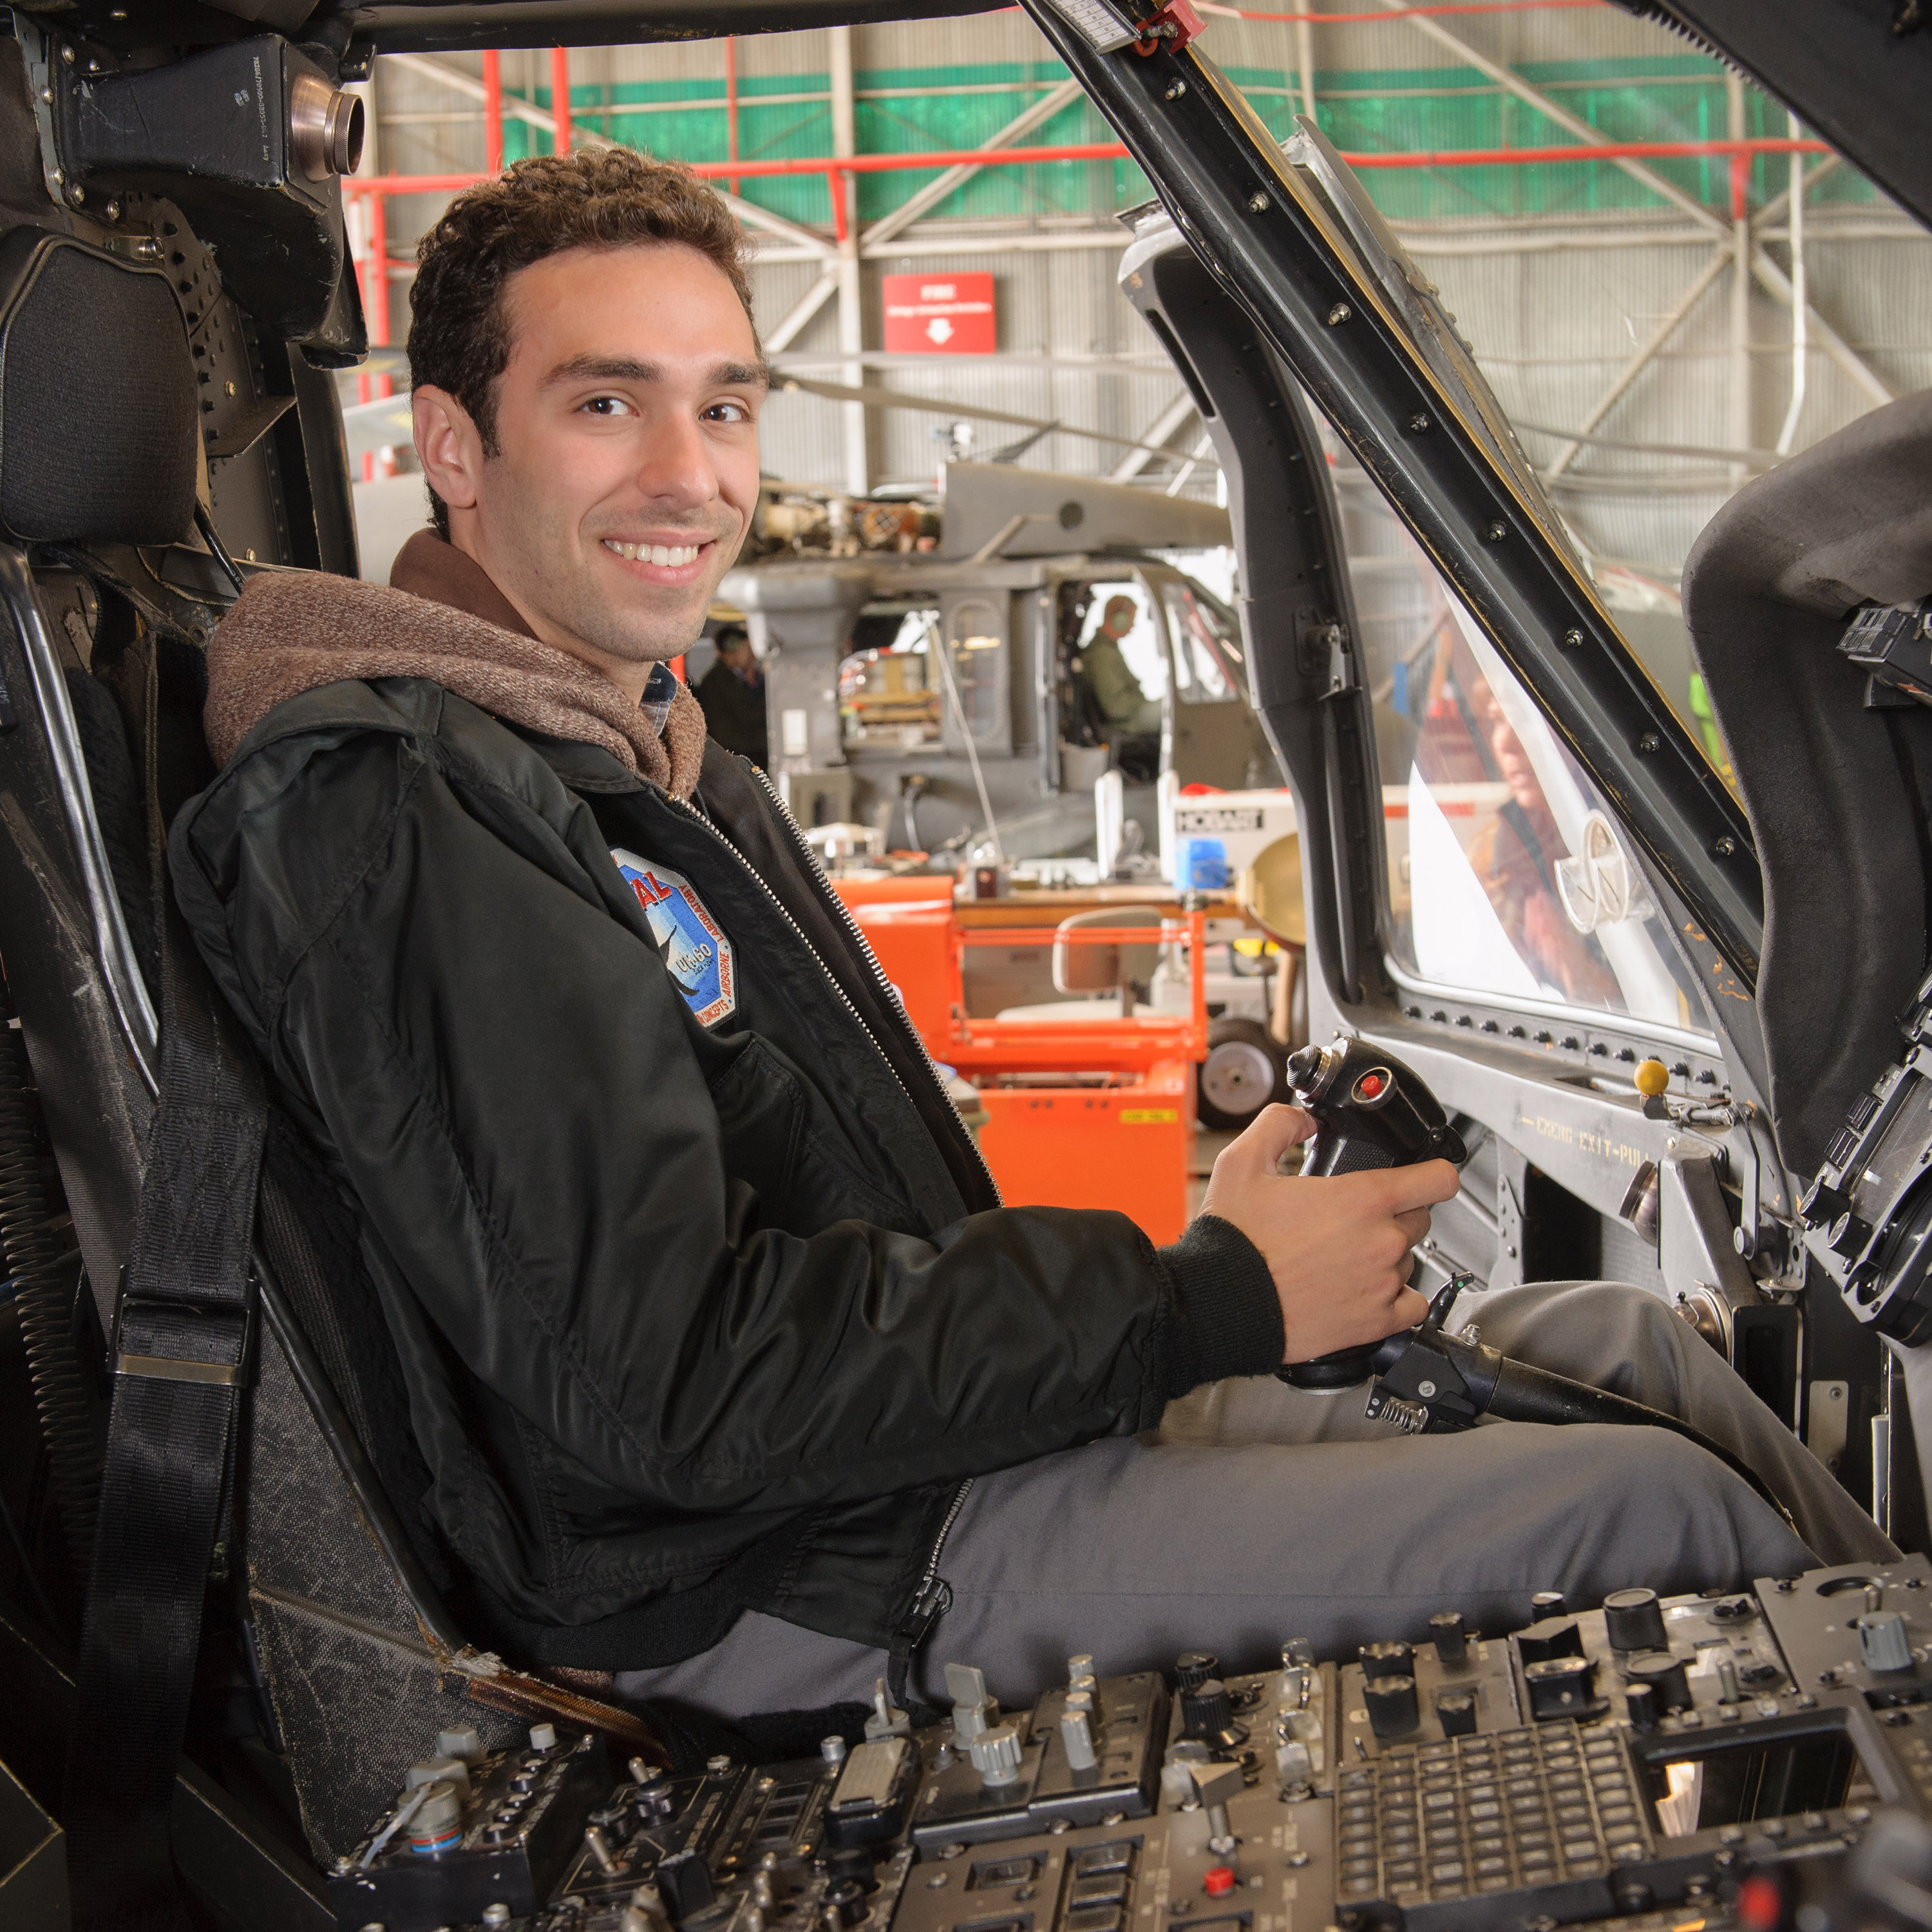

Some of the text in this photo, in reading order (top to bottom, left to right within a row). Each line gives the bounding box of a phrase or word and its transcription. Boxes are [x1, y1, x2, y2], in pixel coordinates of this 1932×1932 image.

[678, 884, 724, 942] LABORATORY
[676, 943, 712, 972] UH-60
[719, 950, 732, 998] AIRBORNE
[701, 999, 730, 1023] CONCEPTS
